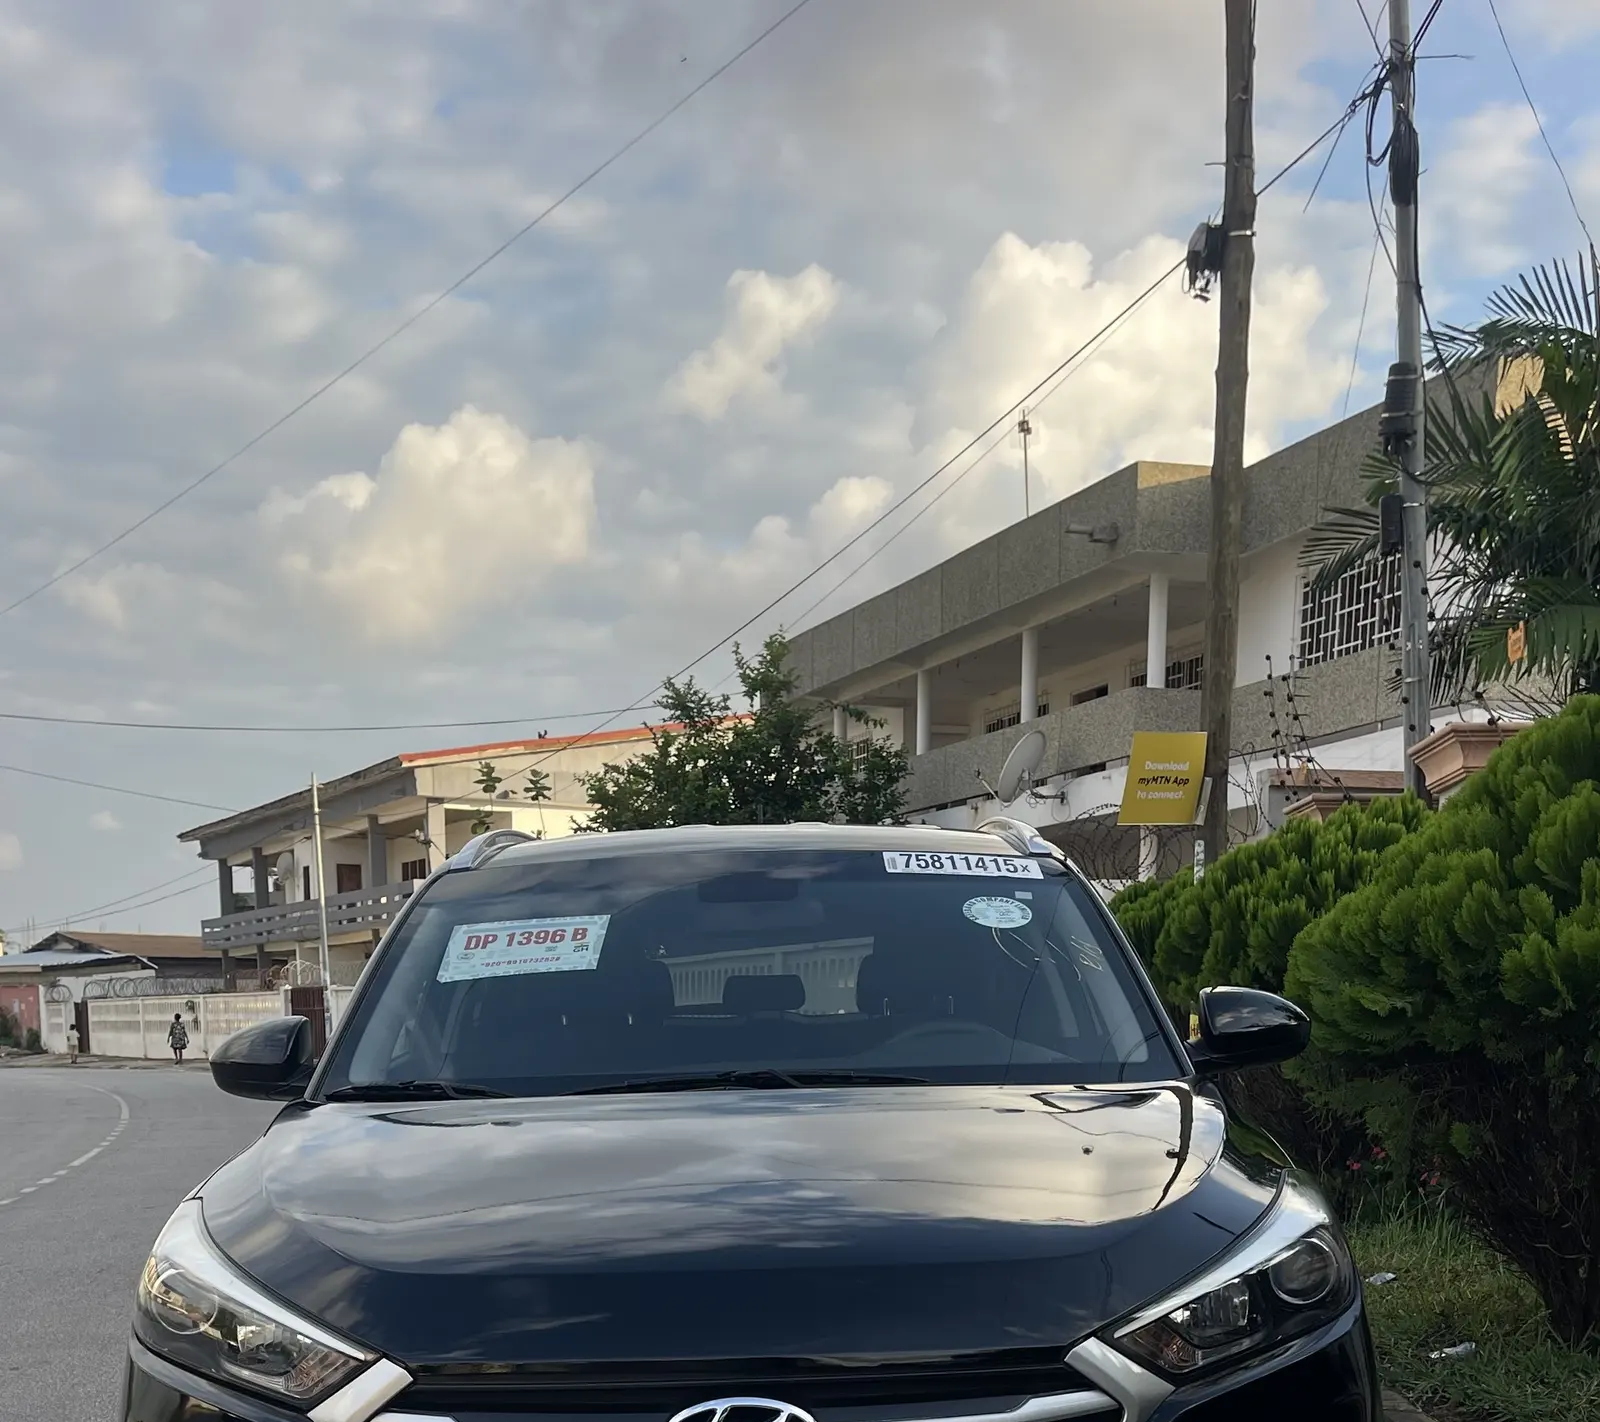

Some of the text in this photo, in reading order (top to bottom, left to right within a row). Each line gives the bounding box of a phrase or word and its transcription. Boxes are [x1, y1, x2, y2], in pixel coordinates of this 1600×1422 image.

[1145, 761, 1189, 771] Download
[1138, 776, 1190, 787] myMTN App
[1148, 790, 1185, 798] connect.
[464, 927, 588, 950] DP 1396 B
